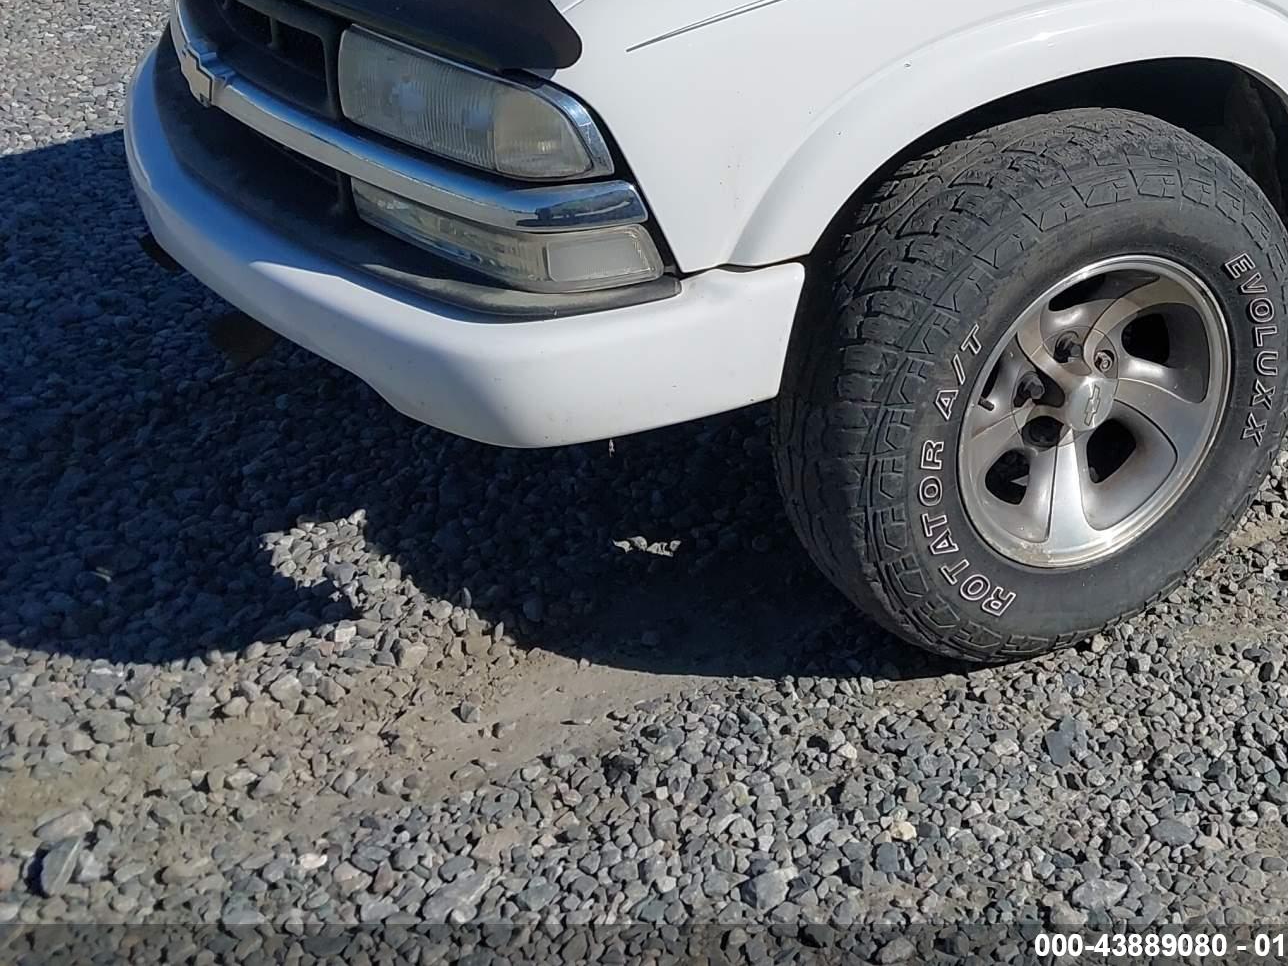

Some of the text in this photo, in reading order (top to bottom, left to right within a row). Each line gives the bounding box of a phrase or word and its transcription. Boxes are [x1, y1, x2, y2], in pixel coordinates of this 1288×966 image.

[918, 321, 1018, 617] ROTATOR A/T
[1223, 251, 1280, 448] EVOLUXX
